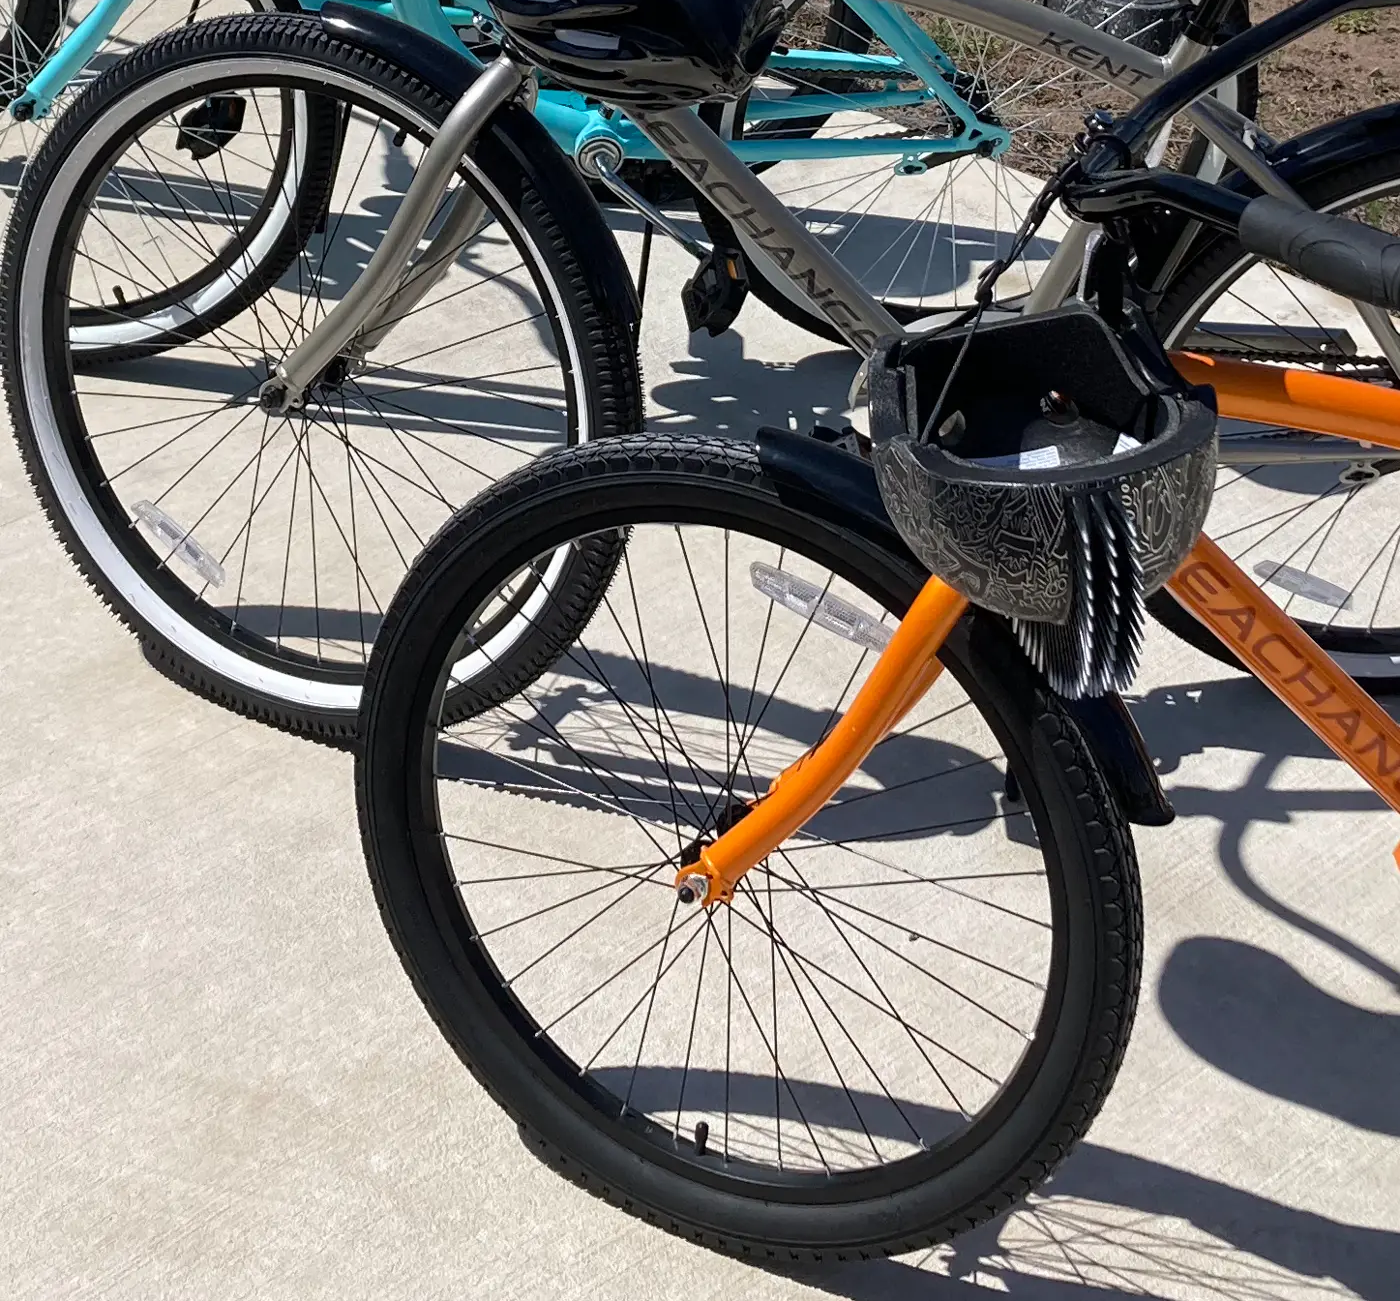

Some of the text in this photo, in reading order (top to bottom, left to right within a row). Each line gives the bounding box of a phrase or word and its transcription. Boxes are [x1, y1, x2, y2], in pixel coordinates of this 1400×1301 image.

[1039, 31, 1154, 87] KENT
[637, 111, 878, 358] EACHANGE
[1178, 561, 1400, 794] EACHAN
